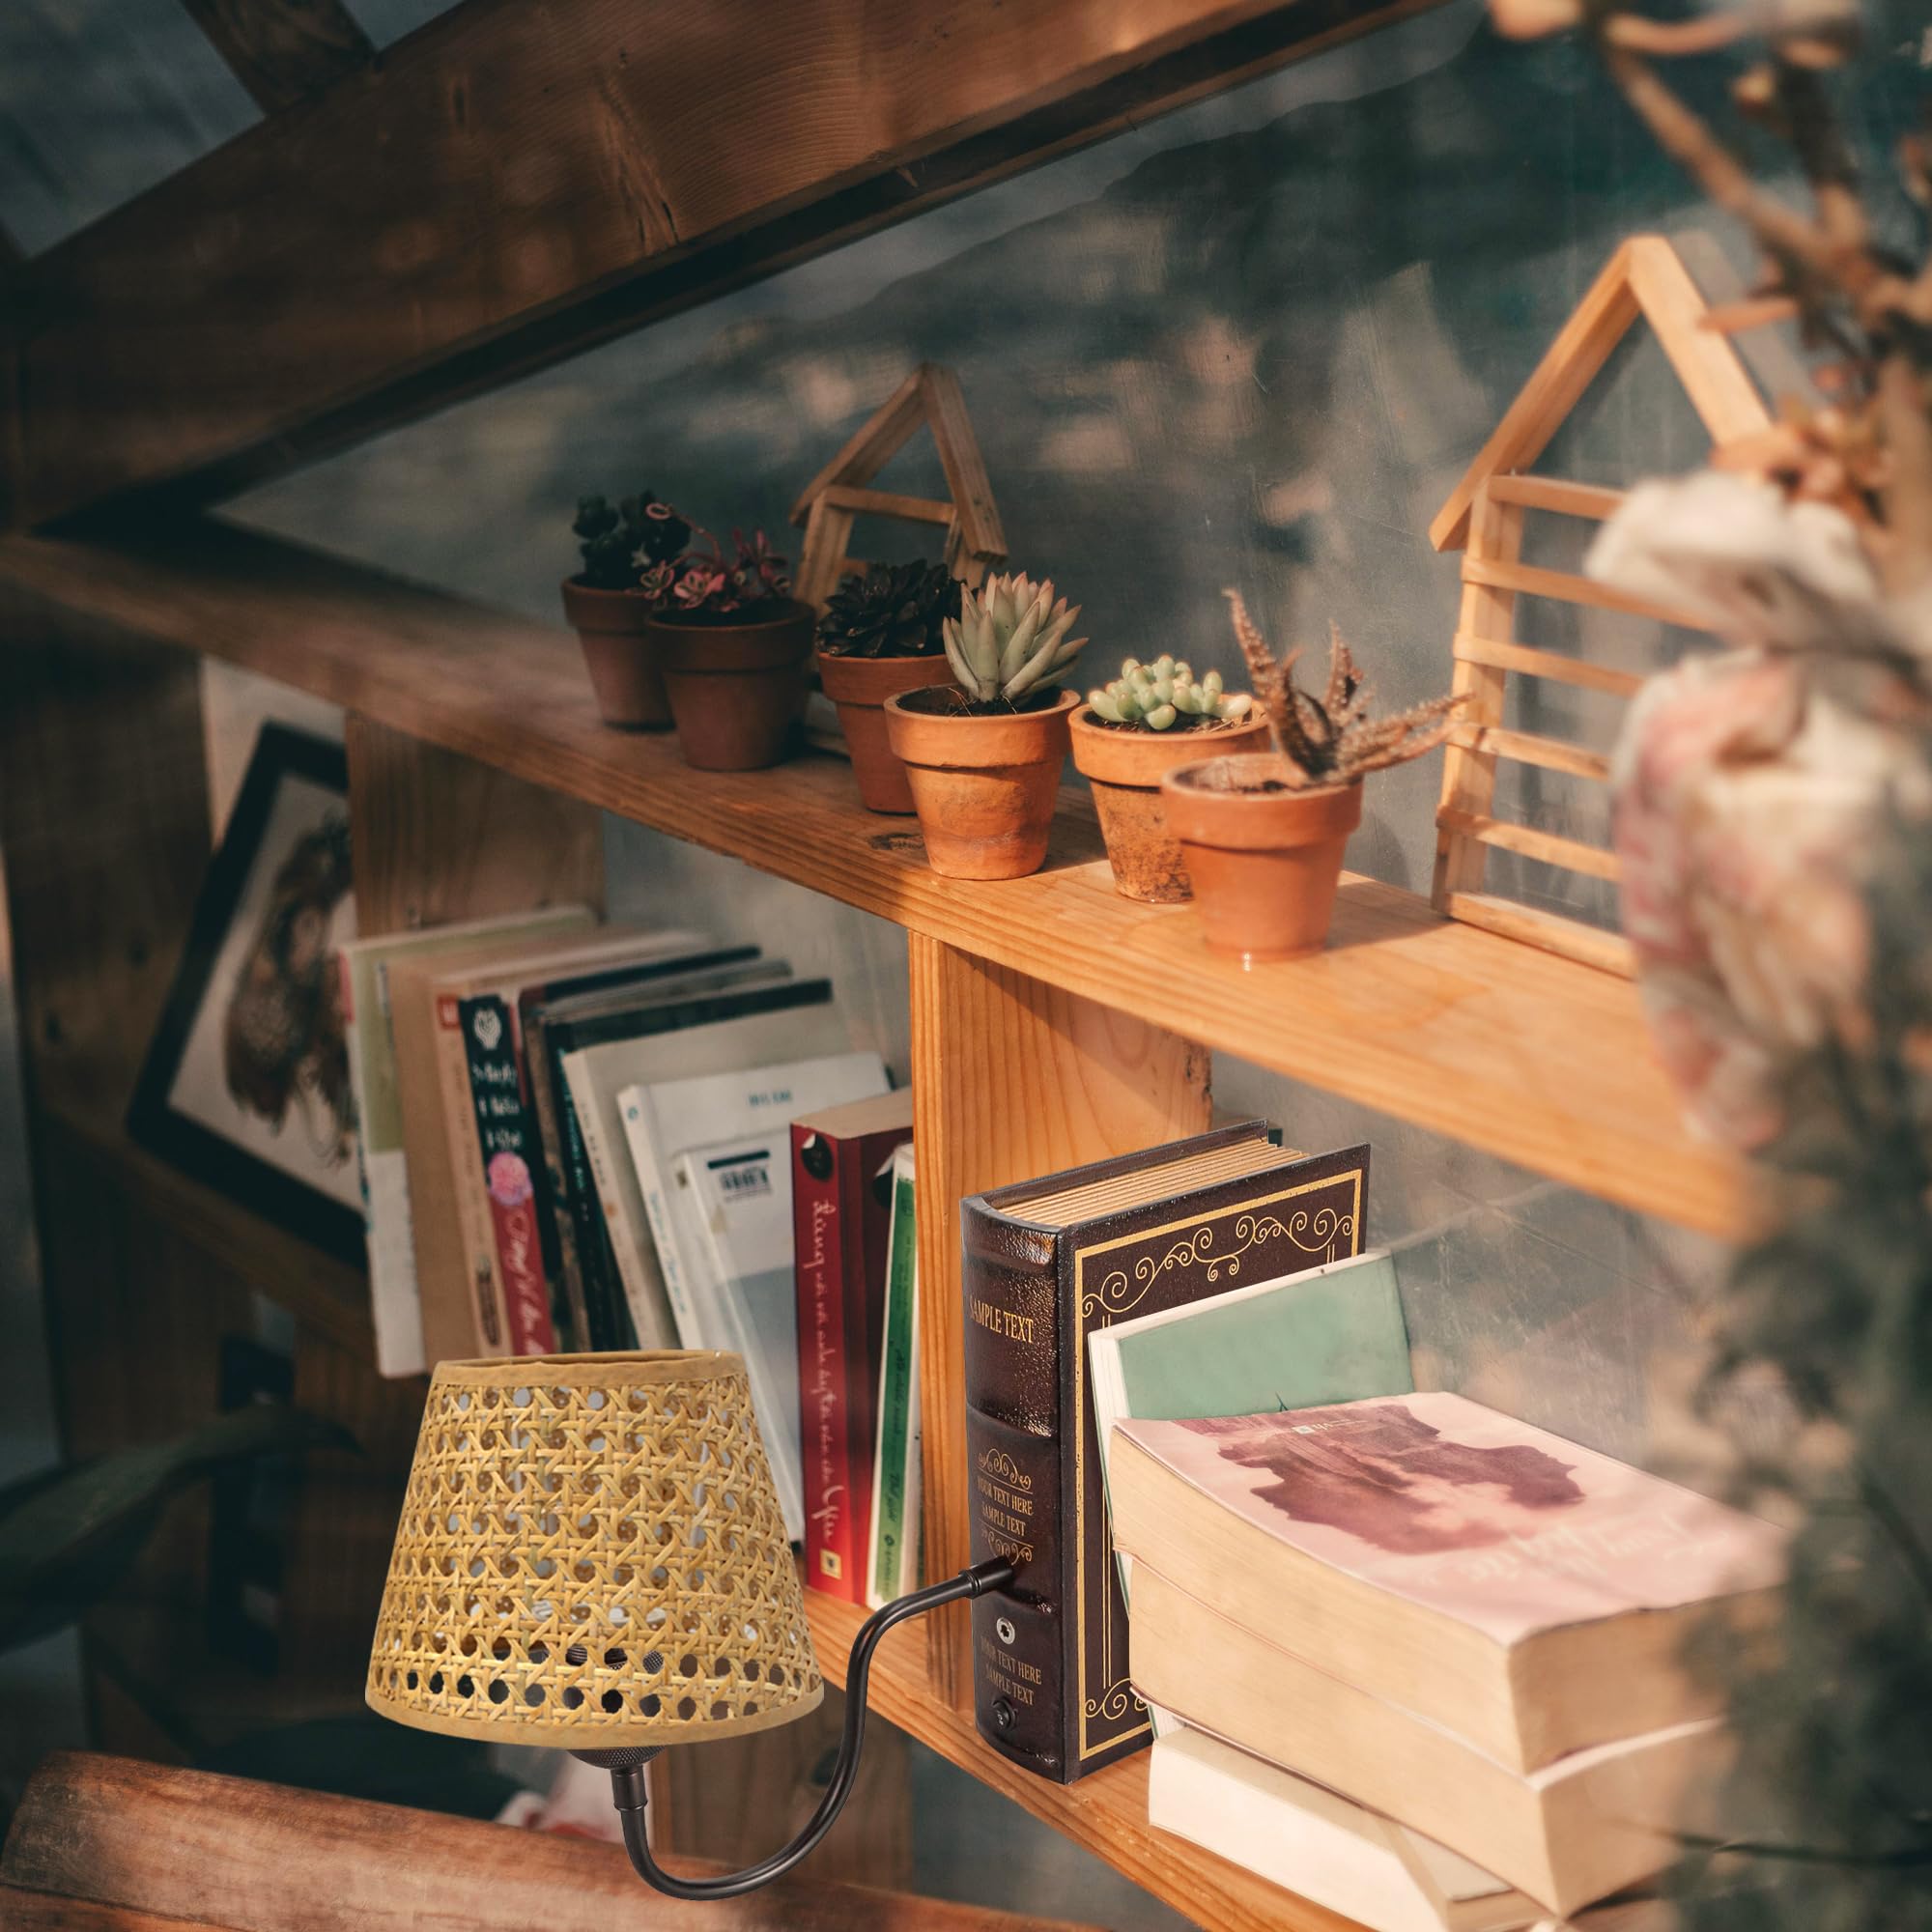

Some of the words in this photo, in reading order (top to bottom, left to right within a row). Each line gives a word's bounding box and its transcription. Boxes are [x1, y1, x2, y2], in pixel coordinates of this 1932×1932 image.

[1003, 1311, 1034, 1344] TEXT
[993, 1487, 1010, 1507] TEXT
[1011, 1494, 1034, 1516] HERE
[1007, 1515, 1026, 1536] TEXT
[997, 1649, 1016, 1674] TEXT
[1017, 1659, 1042, 1685] HERE
[1011, 1682, 1035, 1706] TEXT
